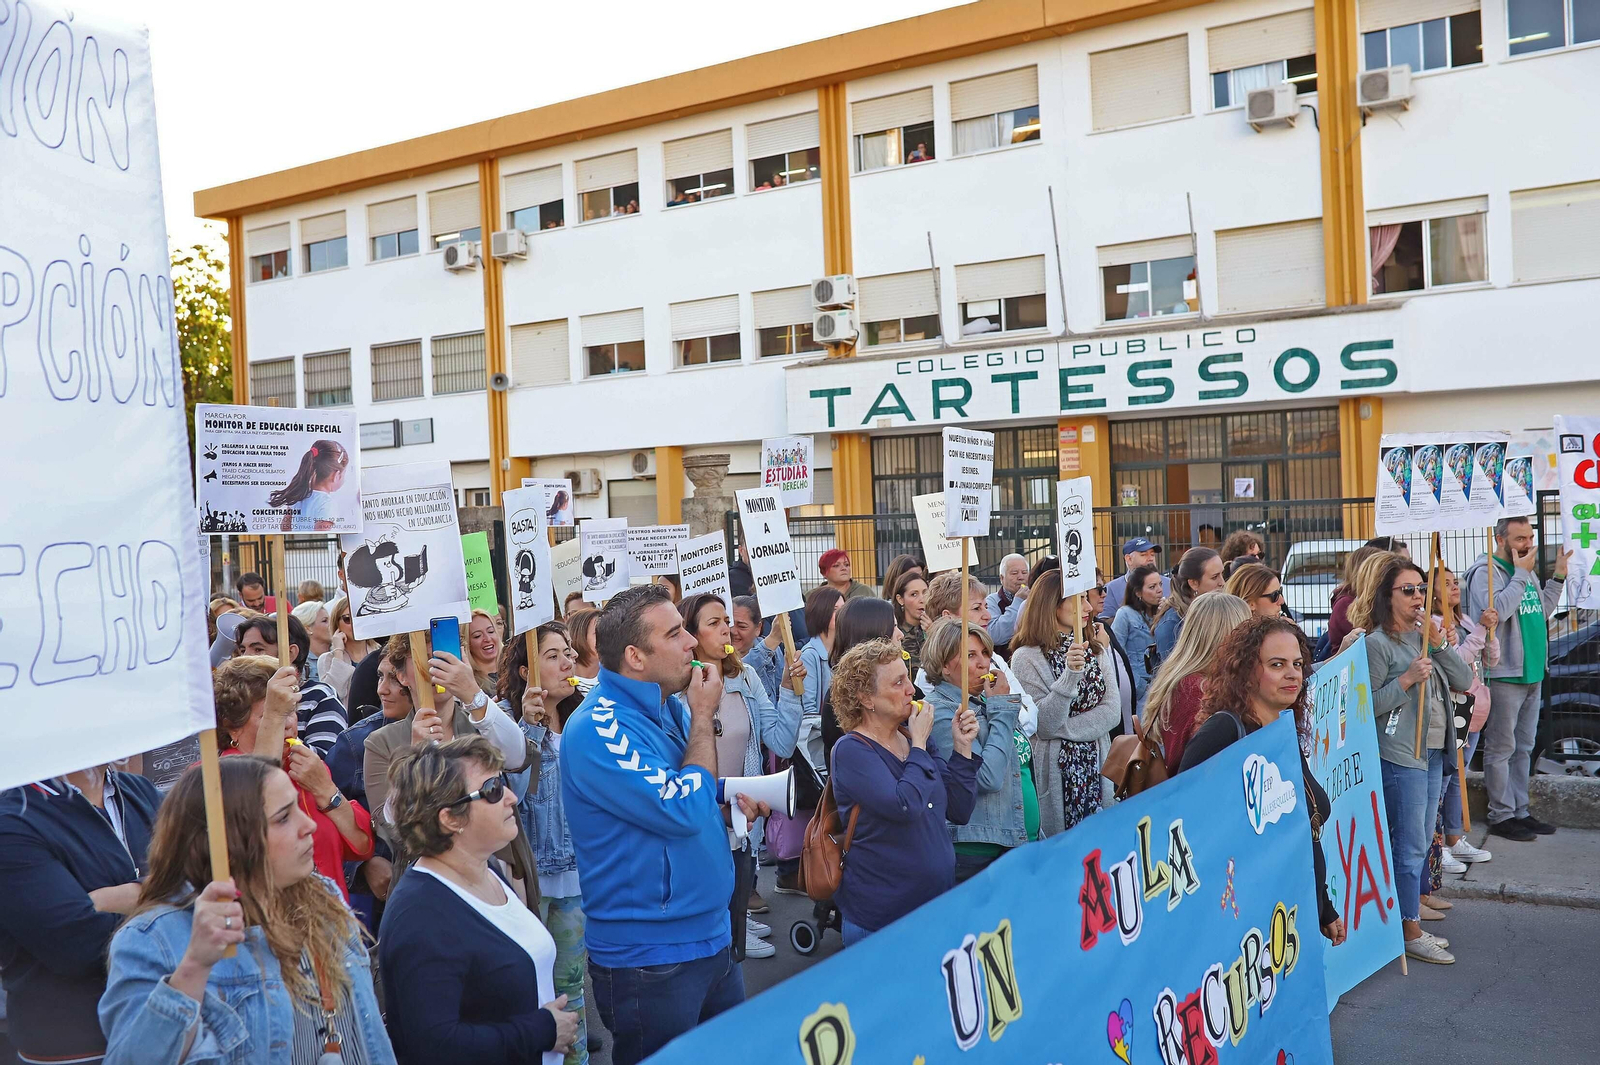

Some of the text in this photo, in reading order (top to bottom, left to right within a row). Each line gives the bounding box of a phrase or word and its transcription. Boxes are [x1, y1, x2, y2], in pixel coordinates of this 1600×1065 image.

[897, 328, 1256, 374] COLEGIO PUBLICO
[810, 339, 1398, 428] TARTESSOS
[205, 420, 342, 434] MONITOR DE EDUCACIÓN ESPECIAL
[948, 449, 959, 458] CON
[765, 465, 808, 483] ESTUDIAR
[783, 480, 809, 491] DERECHO
[362, 498, 380, 509] TANTO
[381, 495, 406, 507] AHORRAR
[406, 494, 414, 504] EN
[745, 496, 777, 513] MONITOR
[1062, 500, 1083, 519] BASTA!
[364, 502, 451, 521] NOS HEMOS HECHO MILLONARIOS
[408, 514, 453, 528] EN IGNORANCIA
[764, 522, 771, 534] A
[680, 542, 723, 562] MONITORES
[751, 542, 790, 559] JORNADA
[937, 541, 961, 551] HACER
[682, 556, 725, 577] ESCOLARES
[685, 571, 726, 591] A JORNADA
[757, 570, 796, 587] COMPLETA
[1316, 674, 1339, 724] CEIP
[1336, 790, 1394, 942] YA!
[1081, 820, 1199, 948] AULA
[943, 925, 1020, 1045] UN
